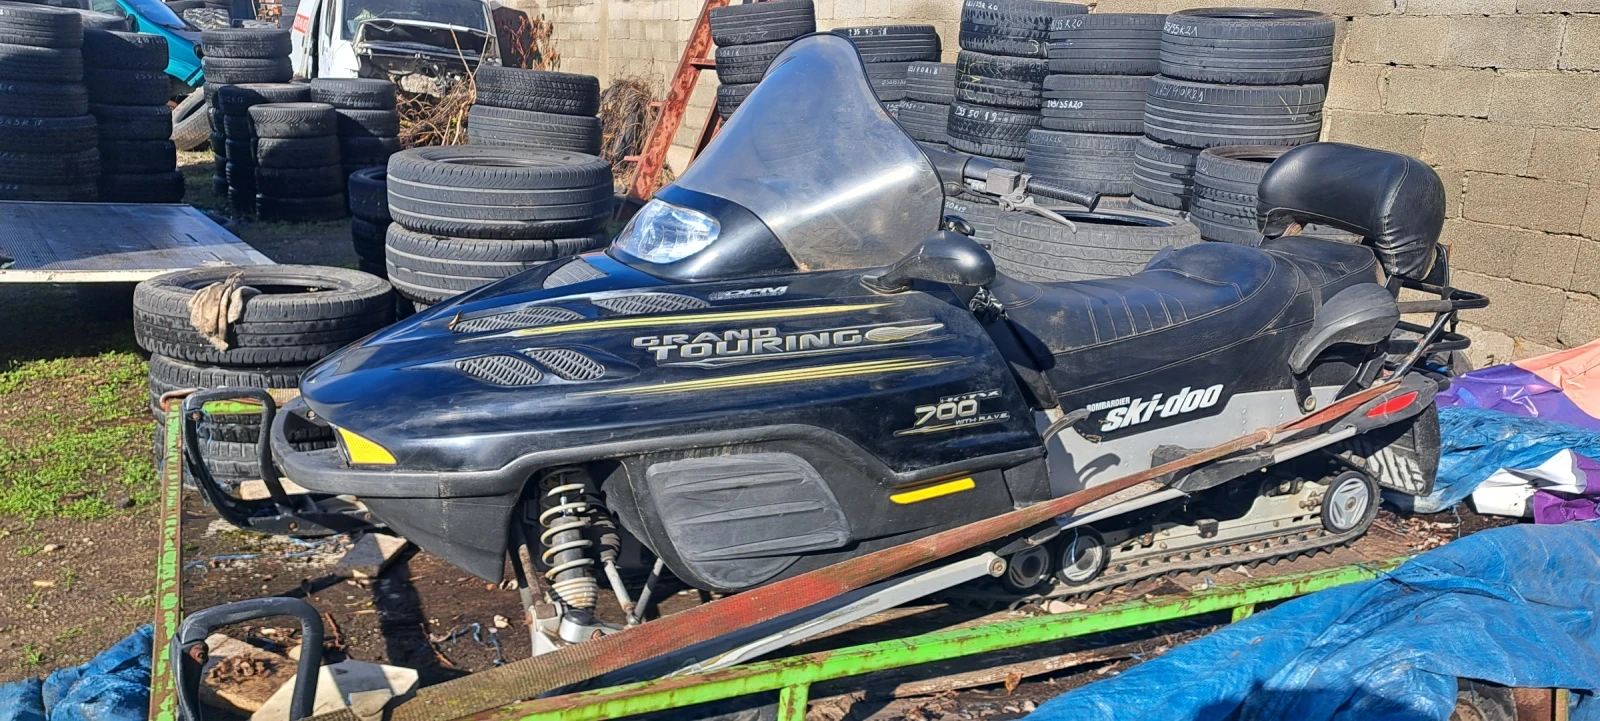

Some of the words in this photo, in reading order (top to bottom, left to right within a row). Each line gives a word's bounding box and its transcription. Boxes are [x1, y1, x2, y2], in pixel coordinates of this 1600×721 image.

[725, 285, 789, 296] DPM
[633, 326, 778, 348] GRAND
[648, 329, 865, 361] TOURING
[915, 399, 978, 426] 700
[1086, 396, 1132, 413] BOMBARDIER
[1100, 383, 1225, 433] ski-doo
[955, 417, 978, 426] WITH
